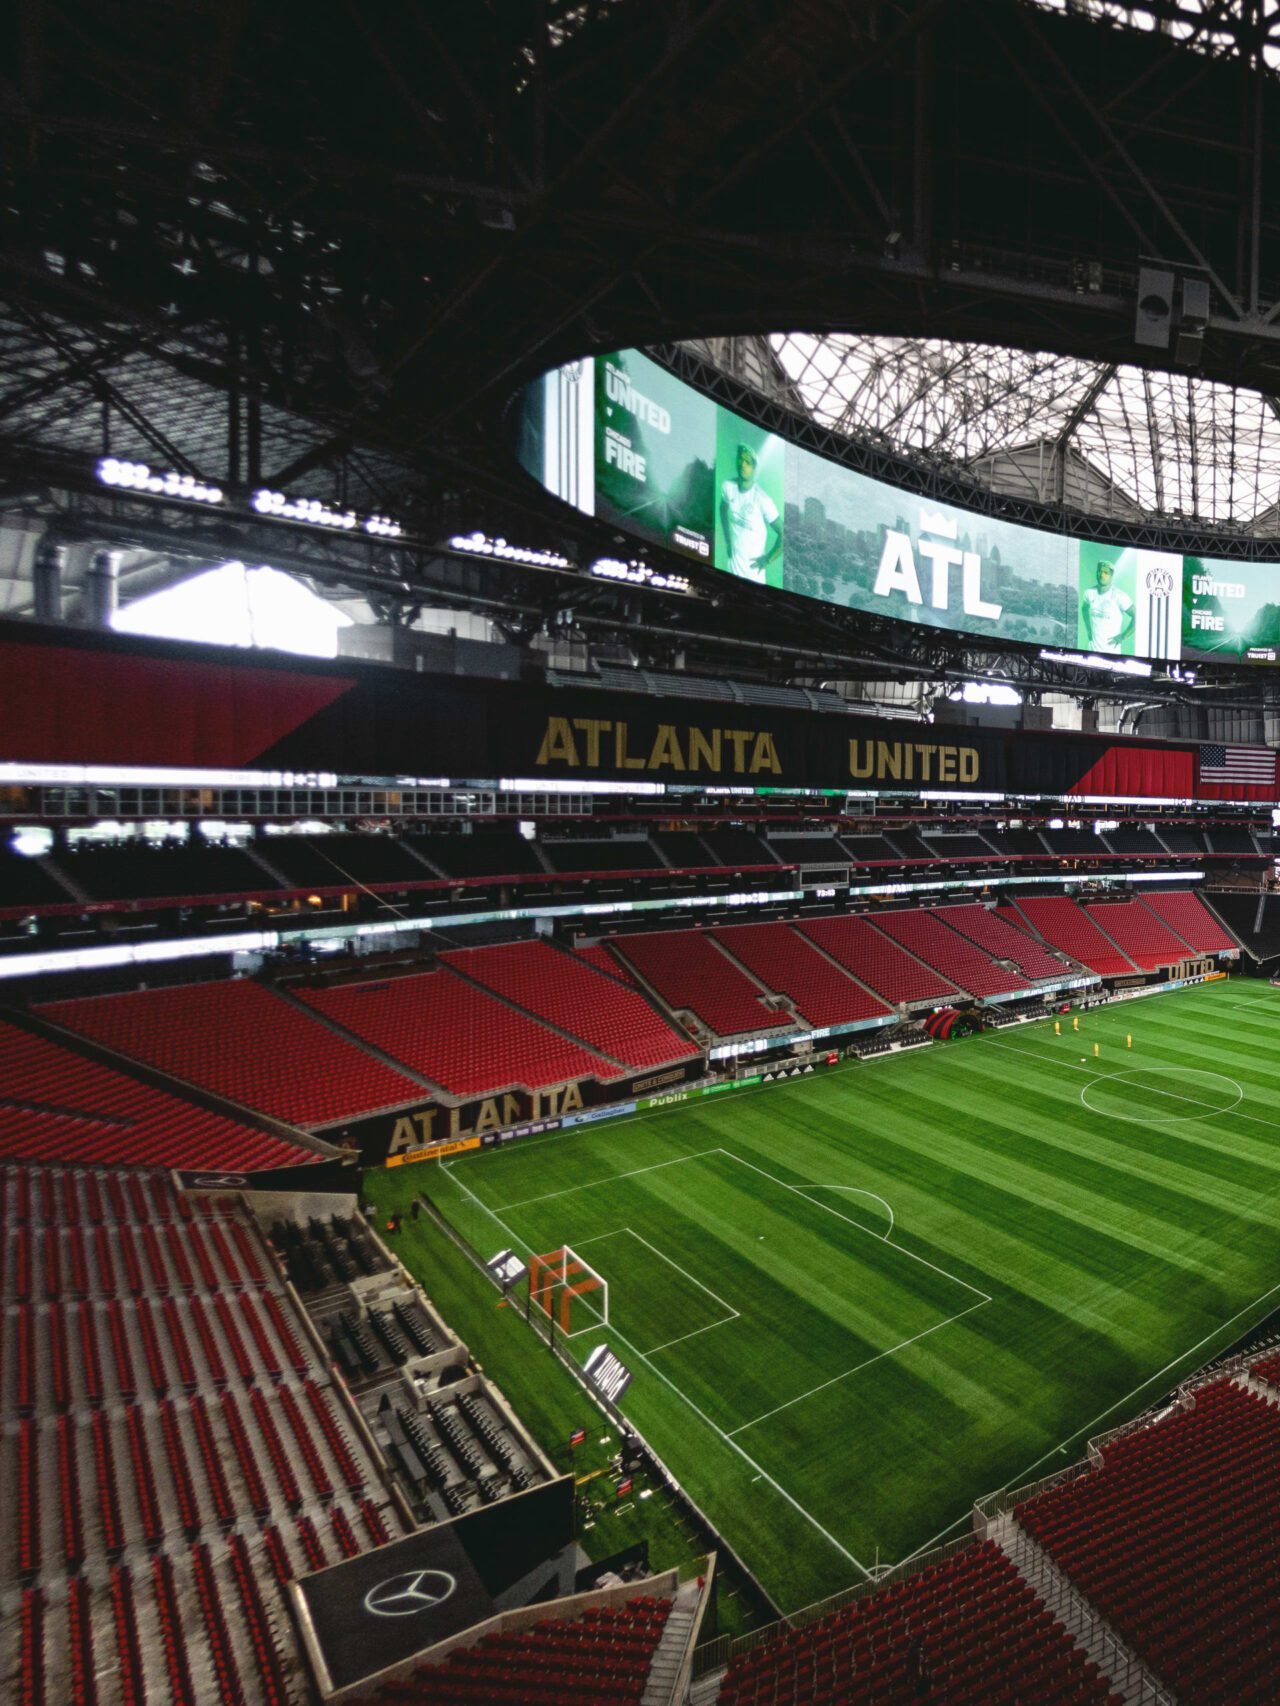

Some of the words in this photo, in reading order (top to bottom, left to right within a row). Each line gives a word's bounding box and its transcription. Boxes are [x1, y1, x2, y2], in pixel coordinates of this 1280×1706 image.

[606, 369, 671, 435] UNITED
[605, 436, 647, 483] FIRE
[873, 529, 1003, 620] ATL
[1192, 579, 1245, 598] UNITED
[1191, 615, 1225, 632] FIRE
[535, 716, 783, 775] ATLANTA
[849, 738, 980, 784] UNITED
[811, 1027, 831, 1040] FIRE
[649, 1092, 688, 1108] Publix
[388, 1083, 585, 1155] ATLANTA
[590, 1107, 625, 1119] Gallagher
[402, 1143, 458, 1163] Continental
